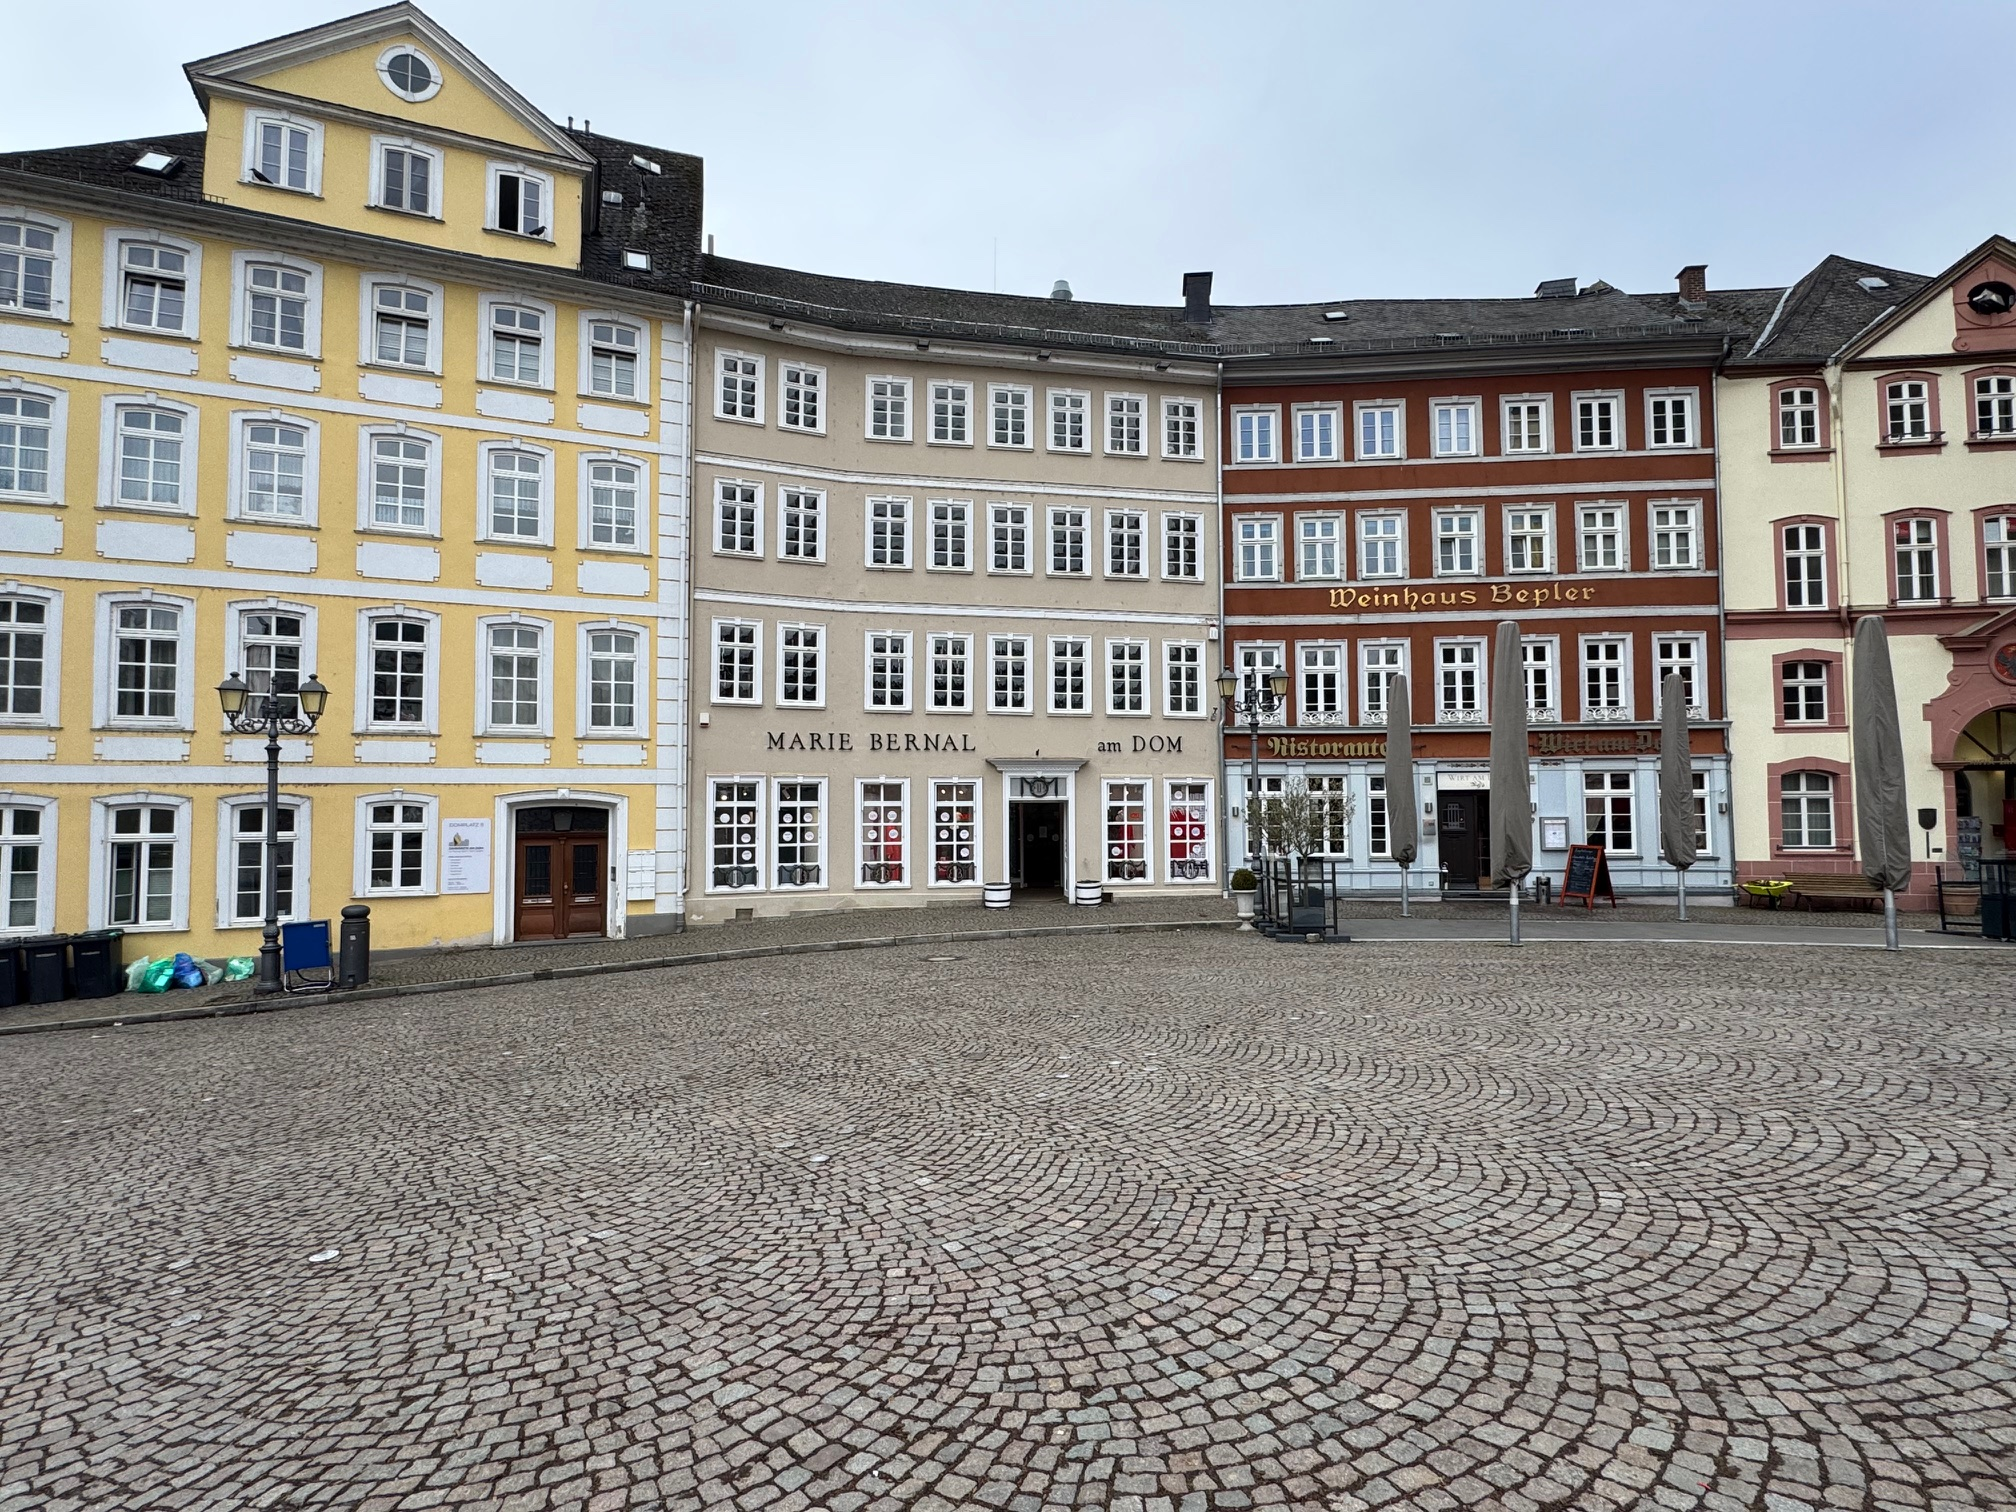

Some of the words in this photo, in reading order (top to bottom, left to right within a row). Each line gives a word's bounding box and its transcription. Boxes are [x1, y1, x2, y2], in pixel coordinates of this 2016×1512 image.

[1329, 586, 1478, 611] Weinhaus
[1489, 582, 1597, 608] Bepler
[766, 731, 854, 751] MARIE
[869, 733, 976, 751] BERNAL
[1097, 741, 1122, 753] am
[1132, 734, 1183, 753] DOM
[1267, 736, 1388, 758] Ristorante
[1538, 732, 1592, 755] Wirt
[1636, 730, 1662, 754] Do
